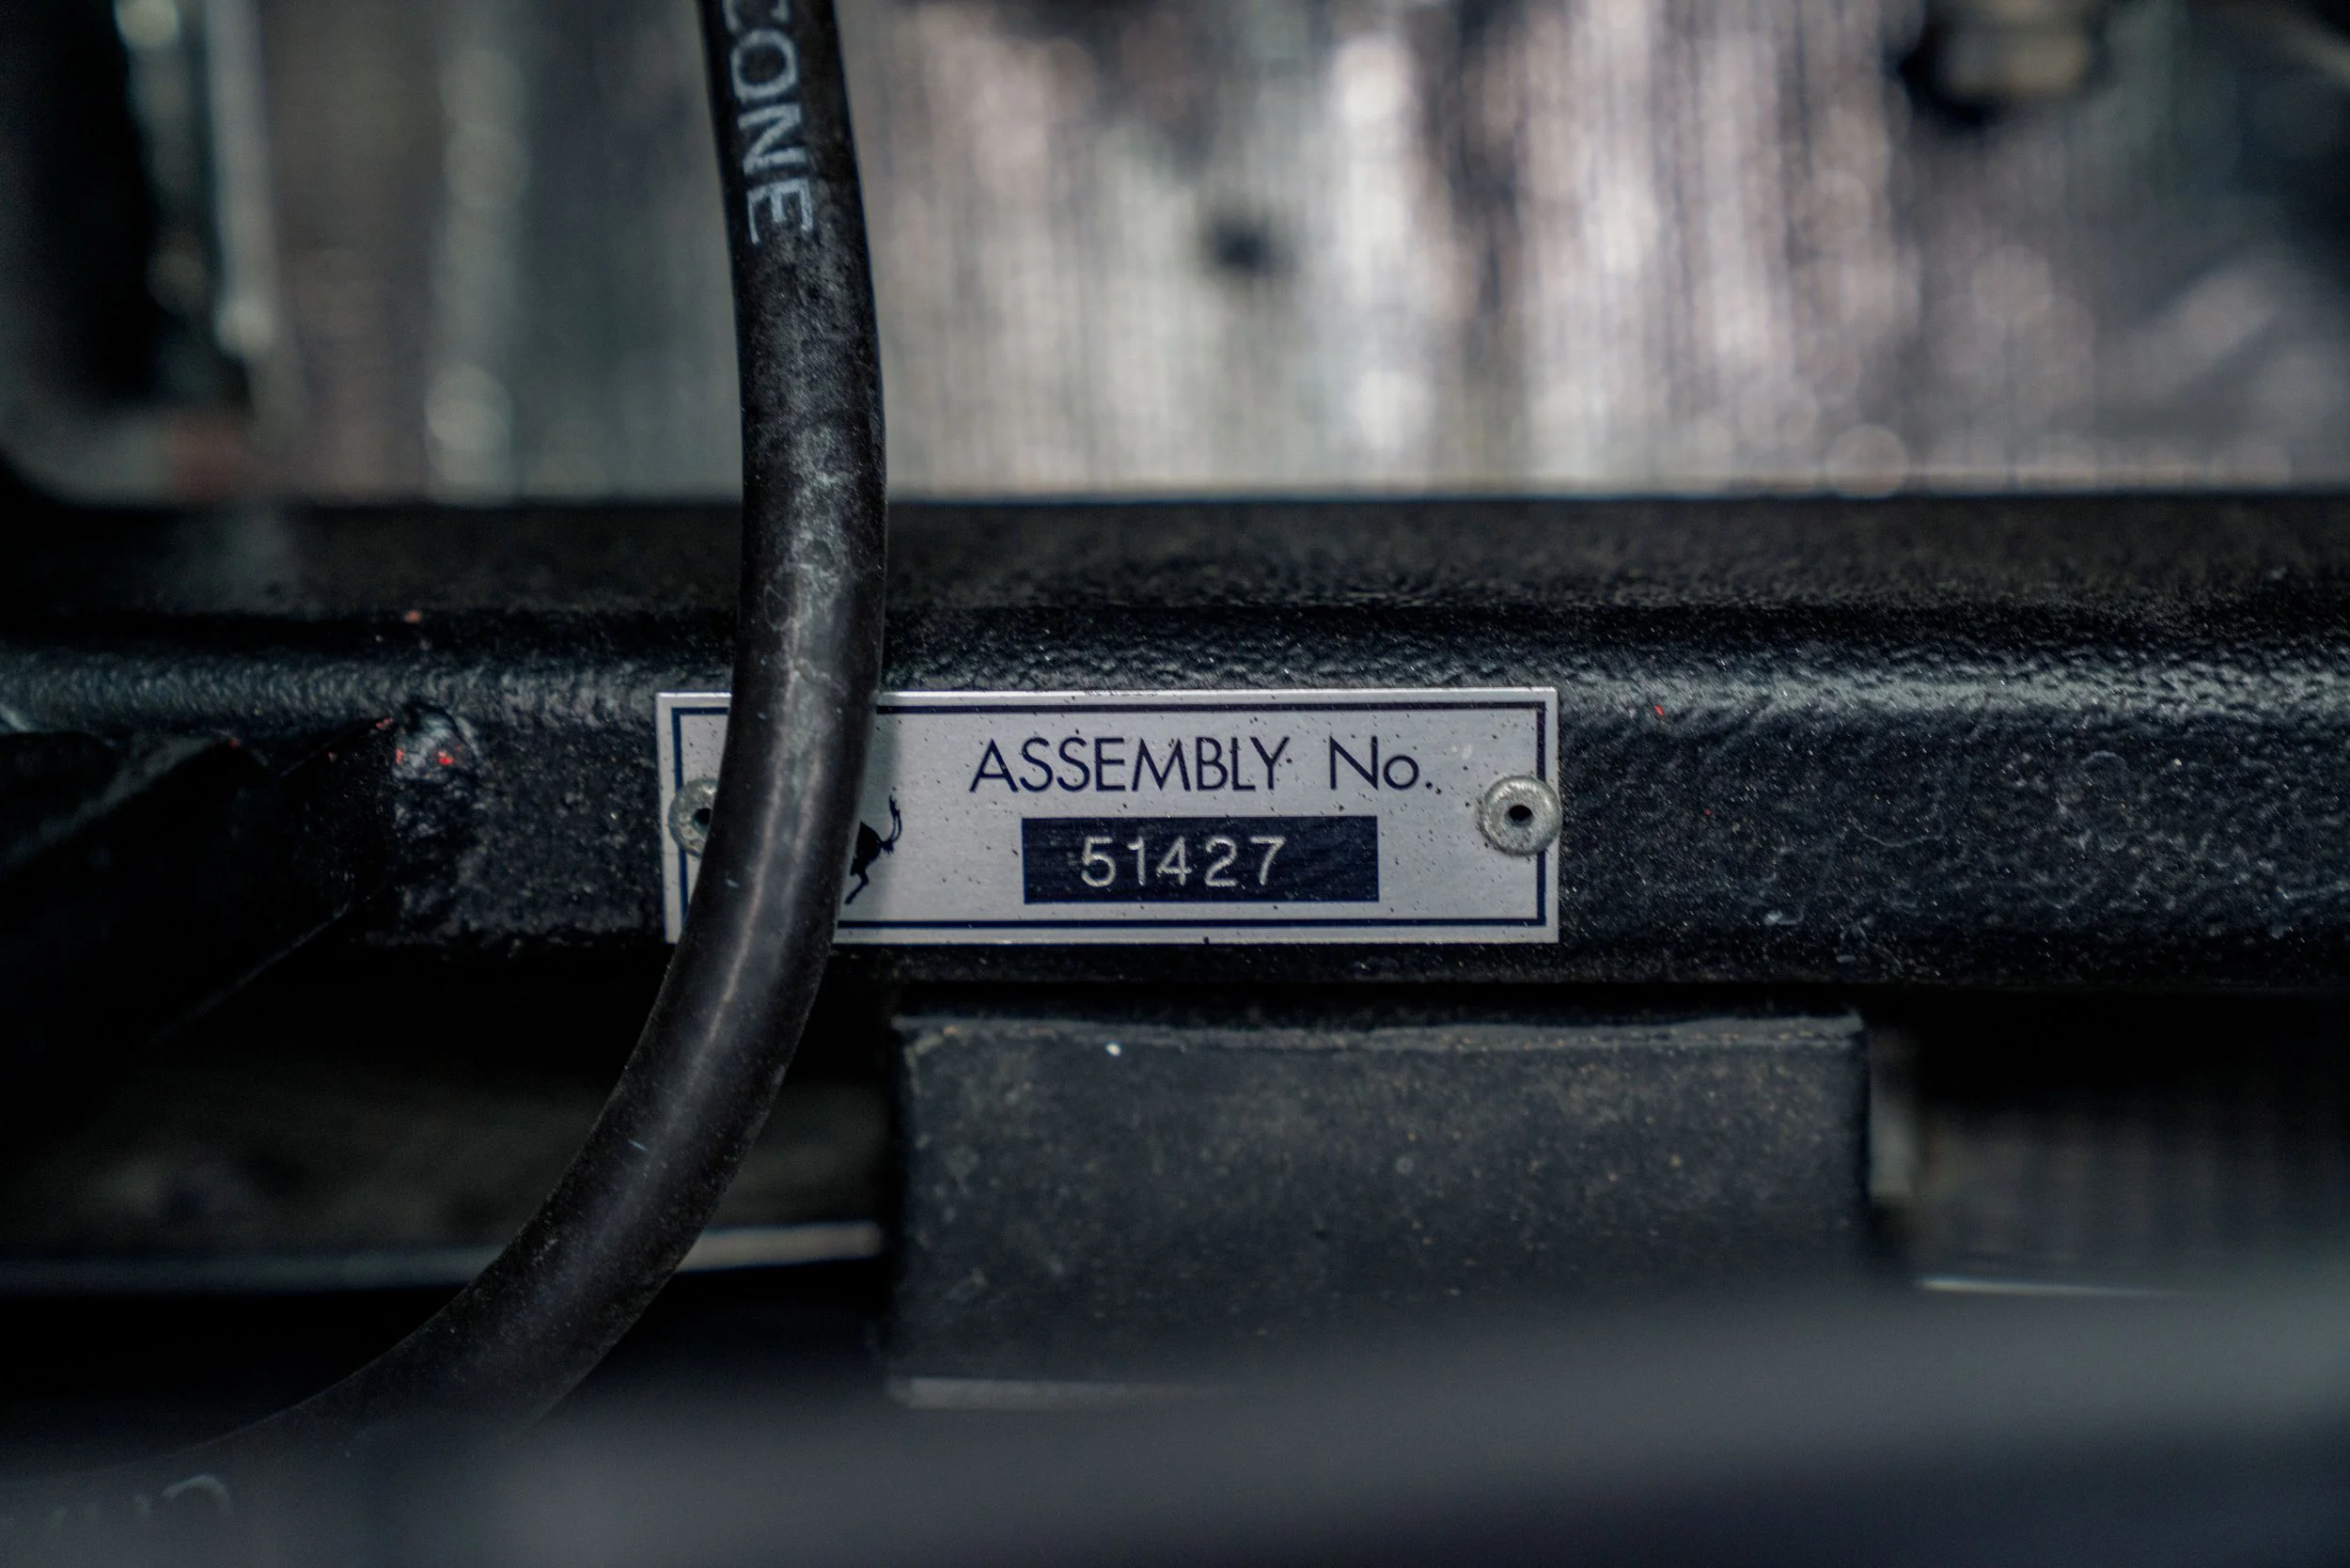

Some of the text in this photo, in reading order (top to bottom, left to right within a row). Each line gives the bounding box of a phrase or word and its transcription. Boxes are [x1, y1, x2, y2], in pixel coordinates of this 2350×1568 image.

[969, 734, 1434, 792] ASSEMBLY No.
[1081, 835, 1287, 887] 51427
